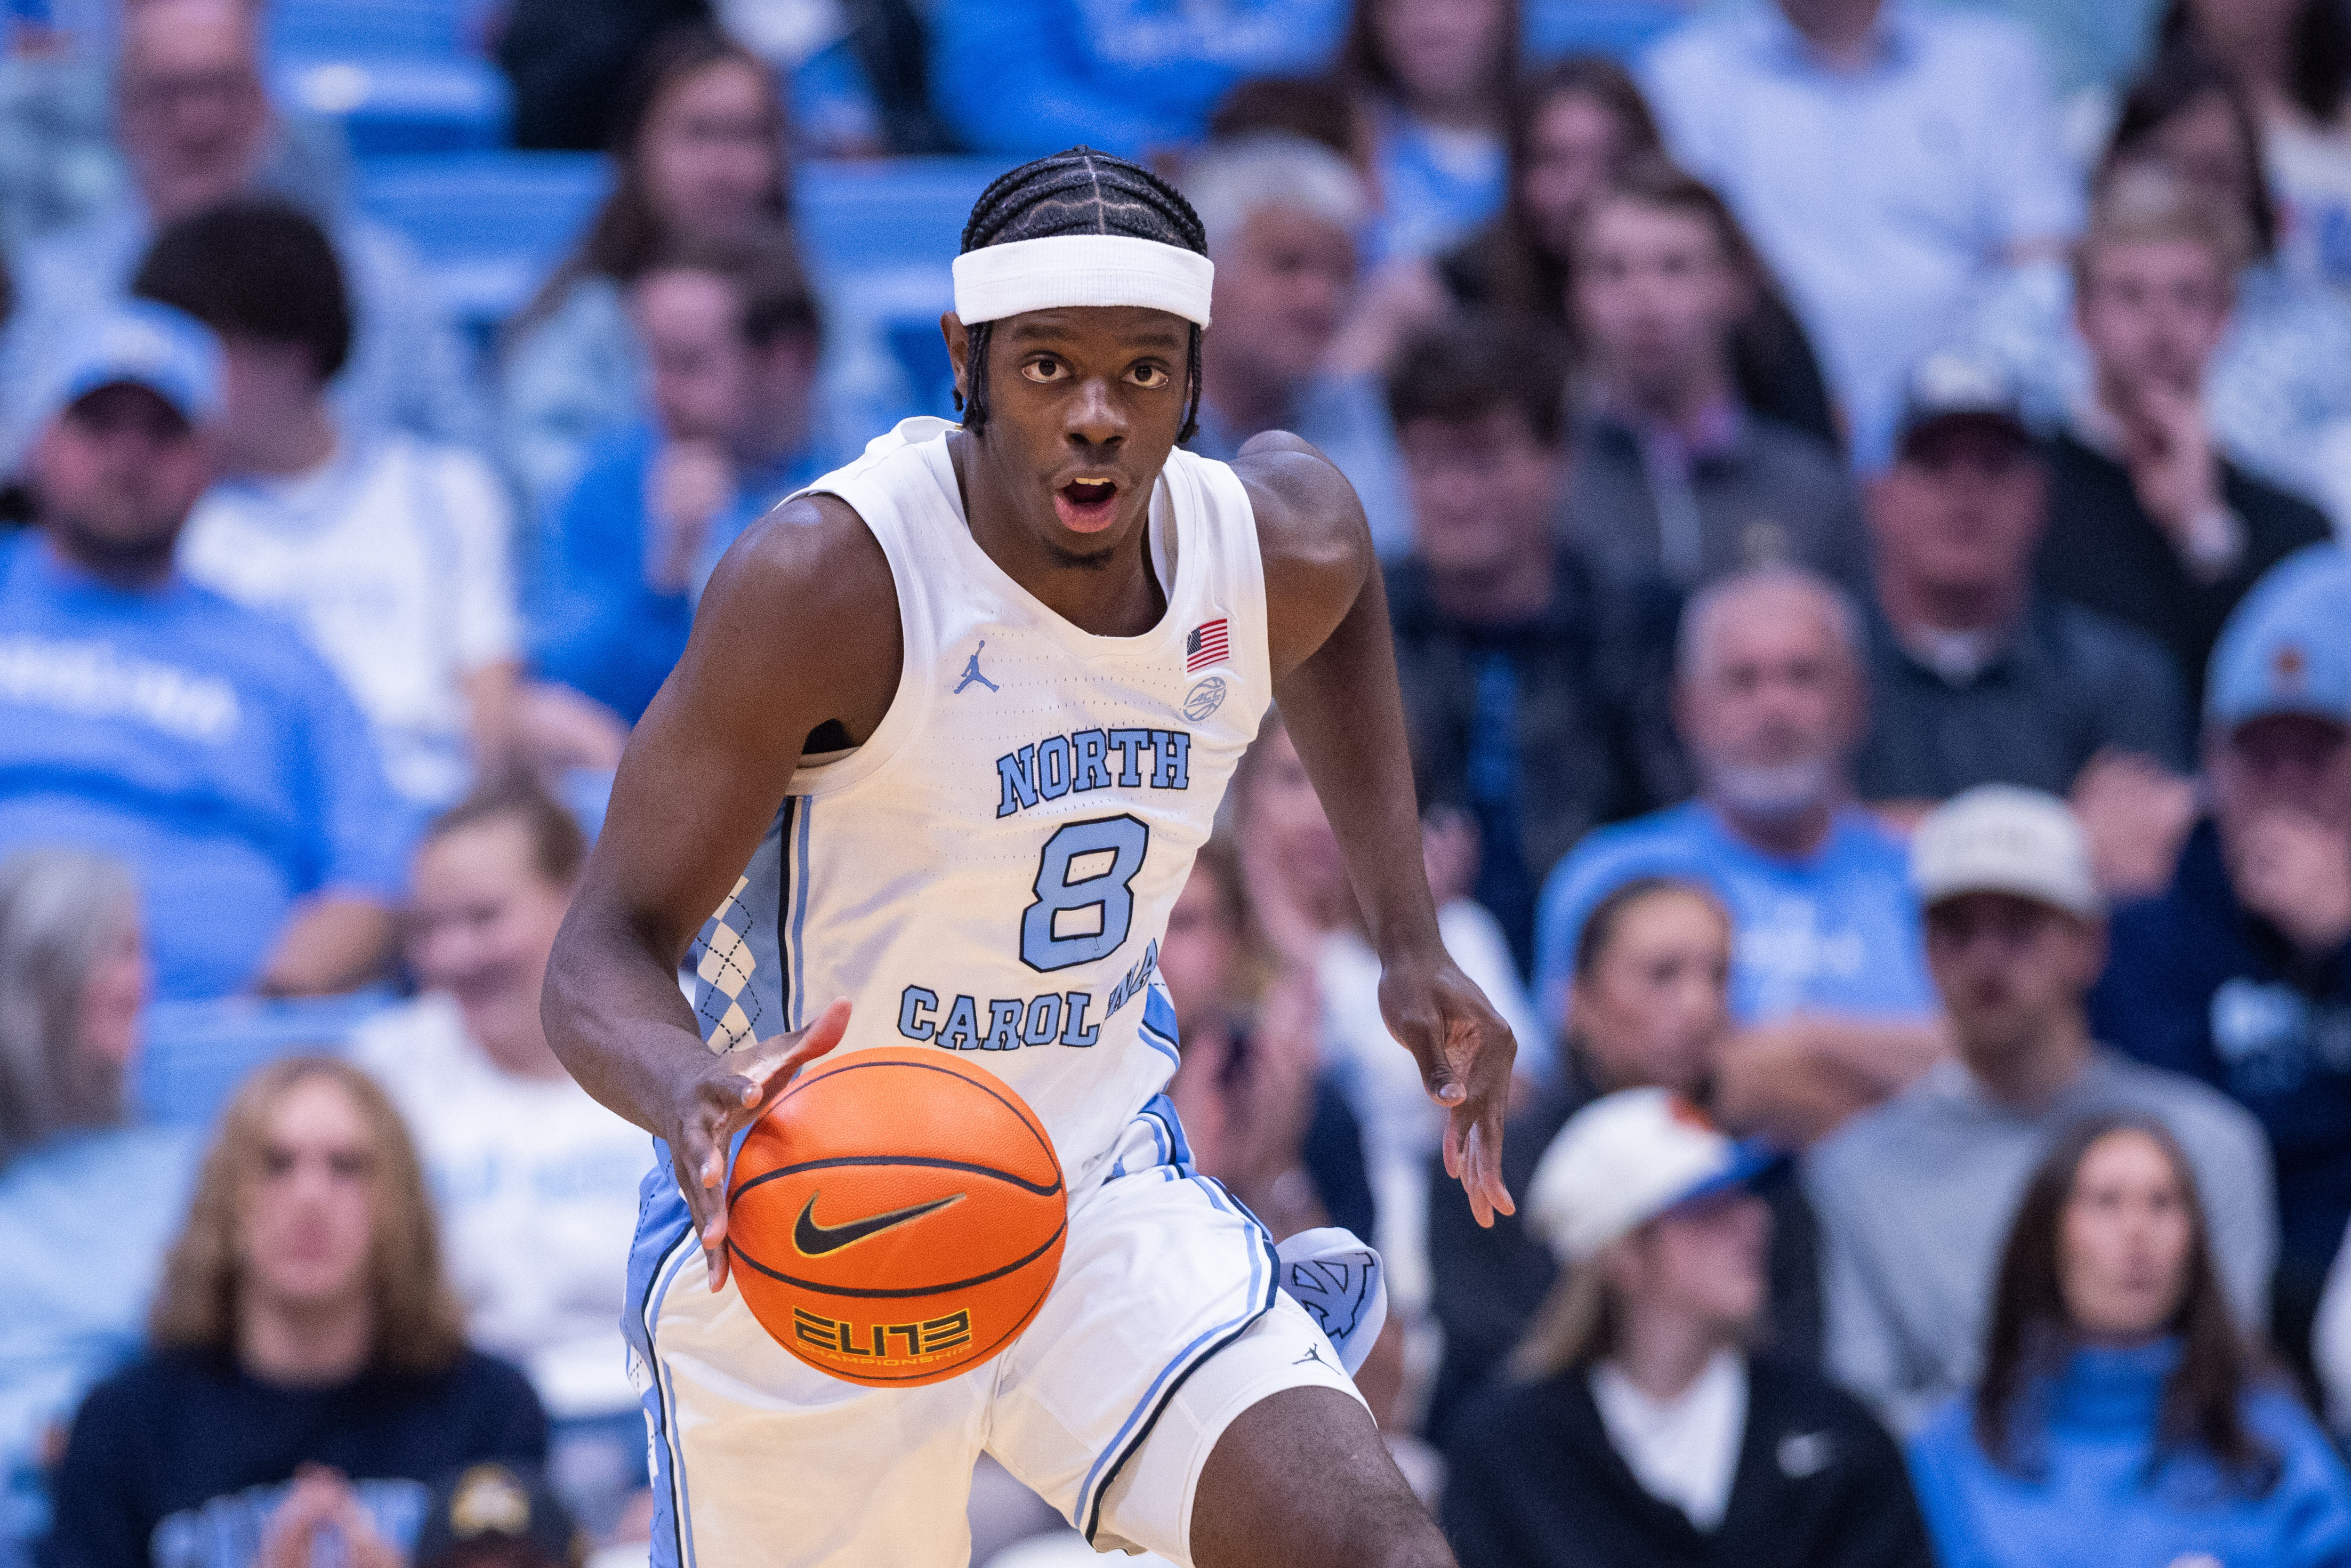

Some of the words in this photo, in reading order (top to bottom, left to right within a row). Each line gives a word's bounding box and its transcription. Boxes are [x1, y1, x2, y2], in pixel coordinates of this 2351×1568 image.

[1188, 688, 1222, 704] ACC
[996, 727, 1190, 819] NORTH
[1019, 813, 1150, 974] 8
[897, 937, 1158, 1051] CAROLNA
[793, 1305, 972, 1358] ELITE
[796, 1341, 973, 1366] CHAMPIONSHIP
